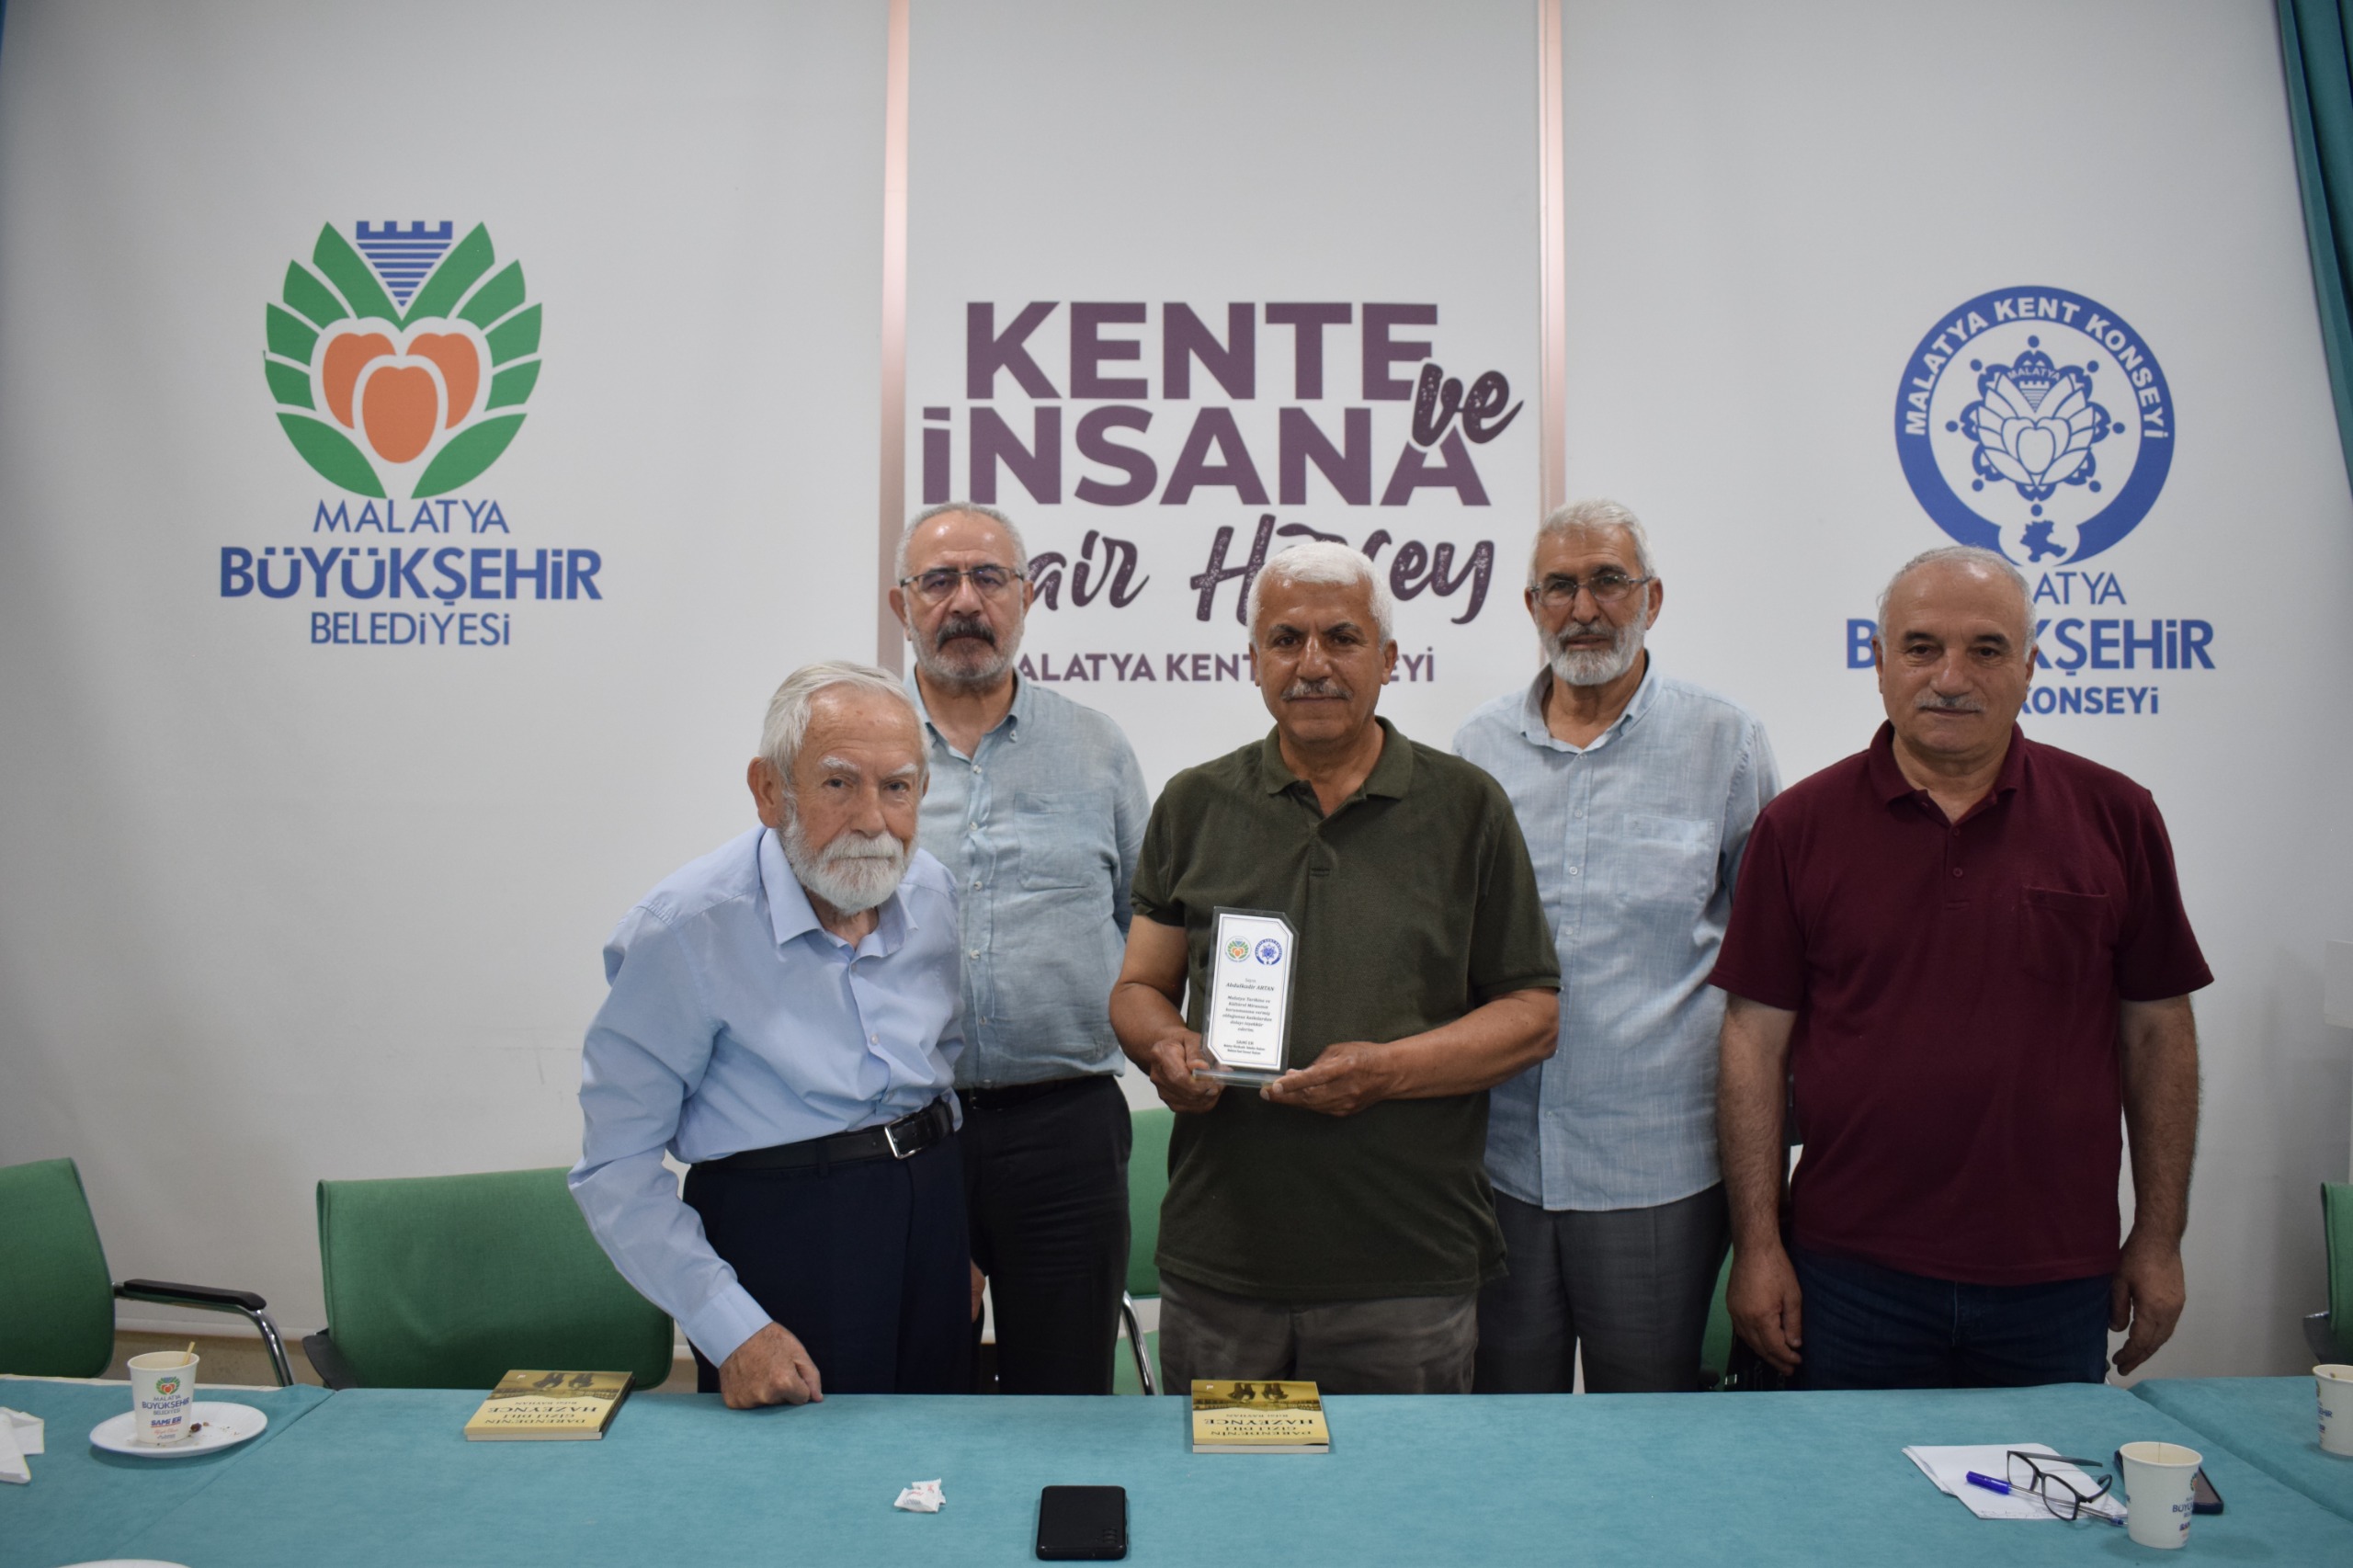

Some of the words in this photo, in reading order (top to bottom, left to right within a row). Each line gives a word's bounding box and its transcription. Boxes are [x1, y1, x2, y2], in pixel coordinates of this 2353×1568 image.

[967, 301, 1438, 401] KENTE
[1412, 362, 1524, 447] ve
[1905, 311, 1989, 436] MALATYA
[1994, 297, 2081, 323] KENT
[2085, 313, 2168, 438] KONSEYİ
[2008, 367, 2060, 381] MALATYA
[923, 405, 1491, 506] İNSANA
[313, 499, 510, 534] MALATYA
[221, 547, 603, 606] BÜYÜKŞEHİR
[1028, 528, 1151, 612] air
[2032, 572, 2127, 606] ATYA
[311, 612, 510, 646] BELEDİYESİ
[1018, 653, 1155, 681] ALATYA
[2022, 687, 2158, 714] ONSEYİ
